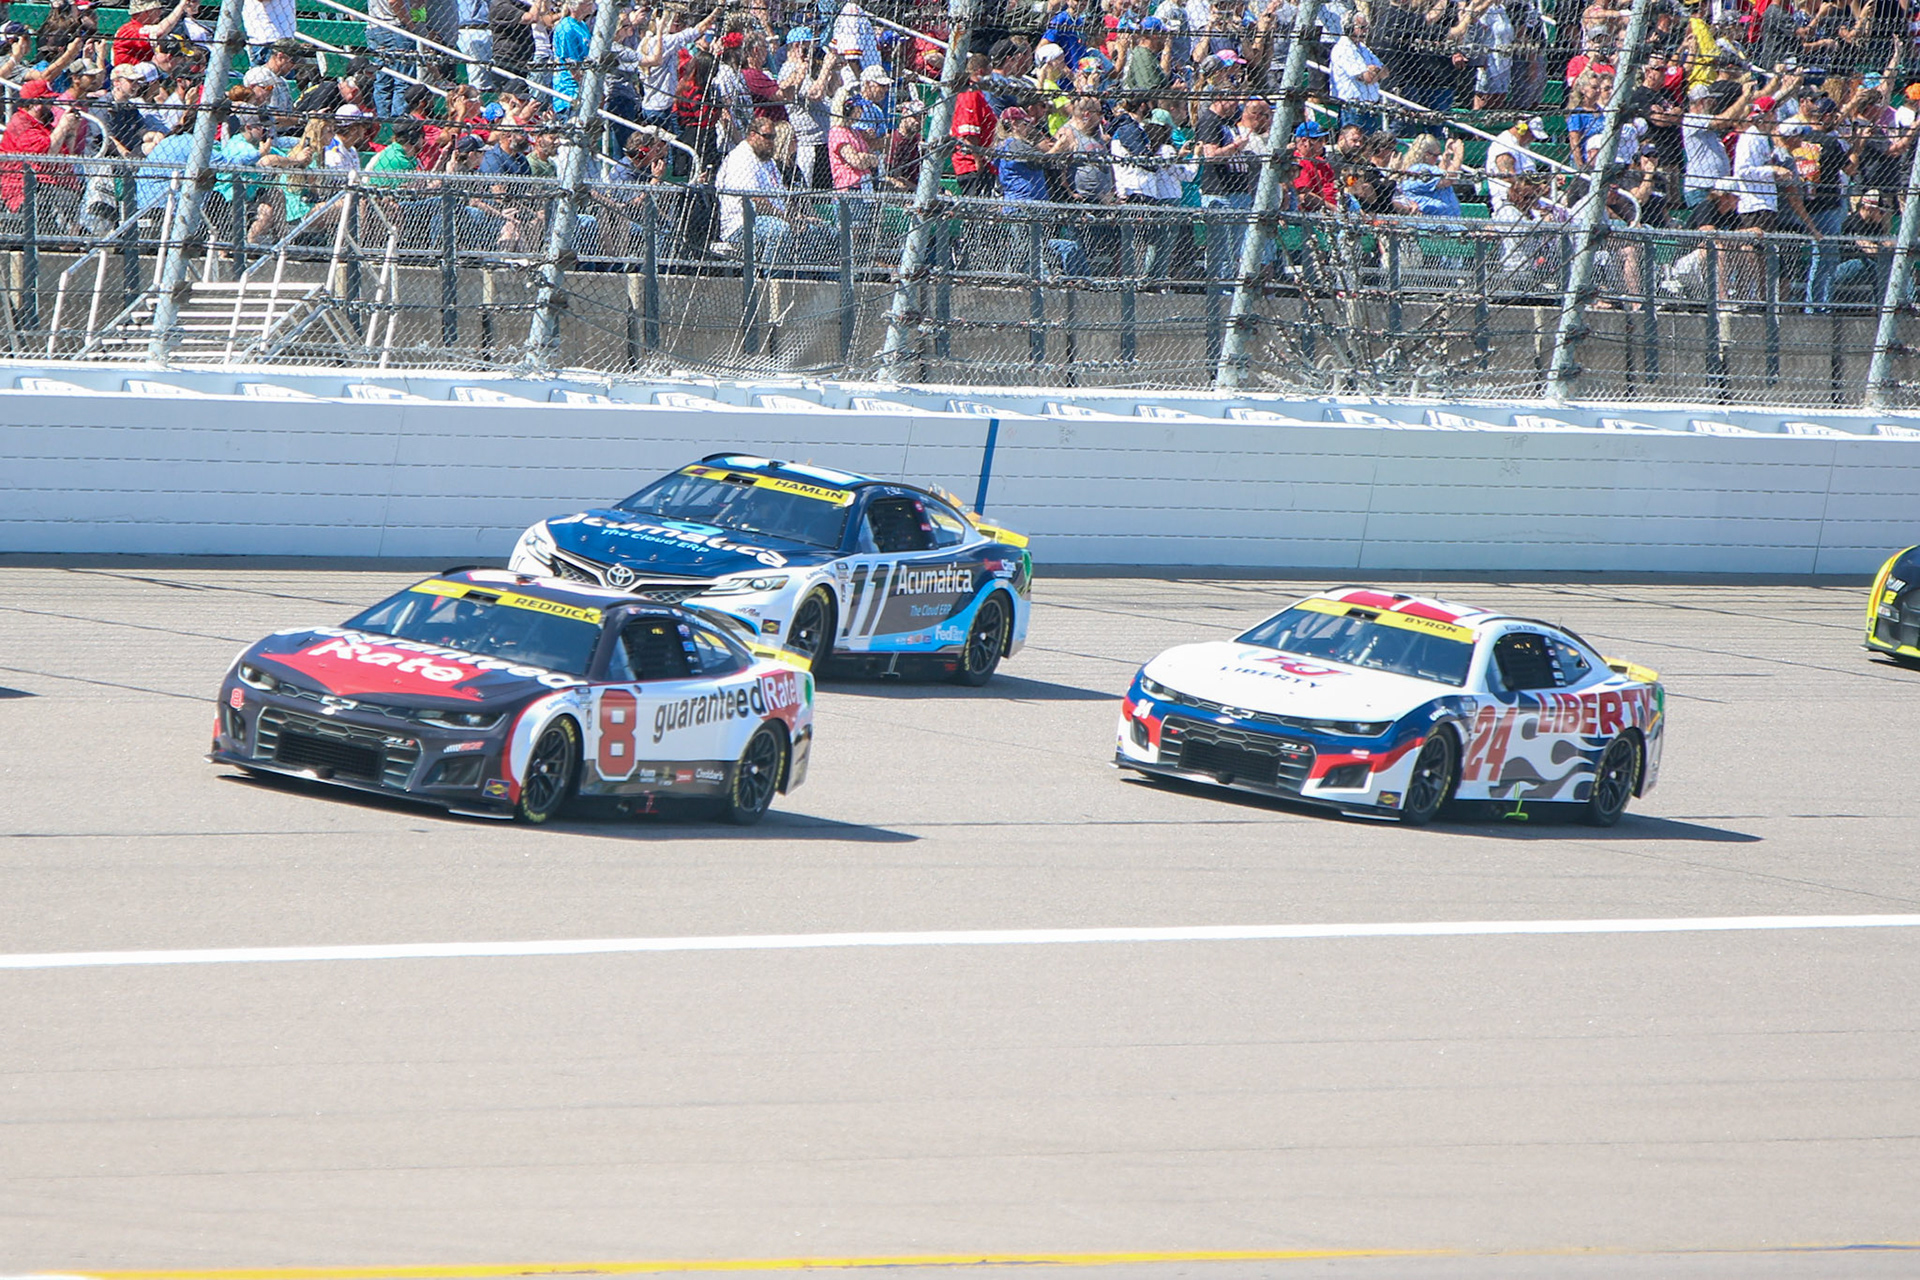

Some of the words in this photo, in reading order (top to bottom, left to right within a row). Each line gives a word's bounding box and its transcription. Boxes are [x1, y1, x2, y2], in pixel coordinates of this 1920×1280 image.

[775, 480, 844, 500] HAMLIN
[548, 512, 788, 568] Acumatica
[601, 528, 629, 539] The
[630, 532, 677, 546] Cloud
[678, 541, 710, 553] ERP
[896, 562, 974, 595] Acumatica
[515, 597, 596, 621] REDDICK
[910, 604, 921, 616] The
[939, 603, 953, 615] ERP
[935, 625, 964, 642] FedEx
[1405, 617, 1458, 633] BYRON
[308, 640, 464, 682] Rate
[1221, 666, 1322, 688] LIBERTY
[653, 677, 768, 744] guaranteed
[1536, 688, 1651, 735] LIBERTY
[596, 688, 637, 781] 8
[1463, 705, 1518, 781] 24
